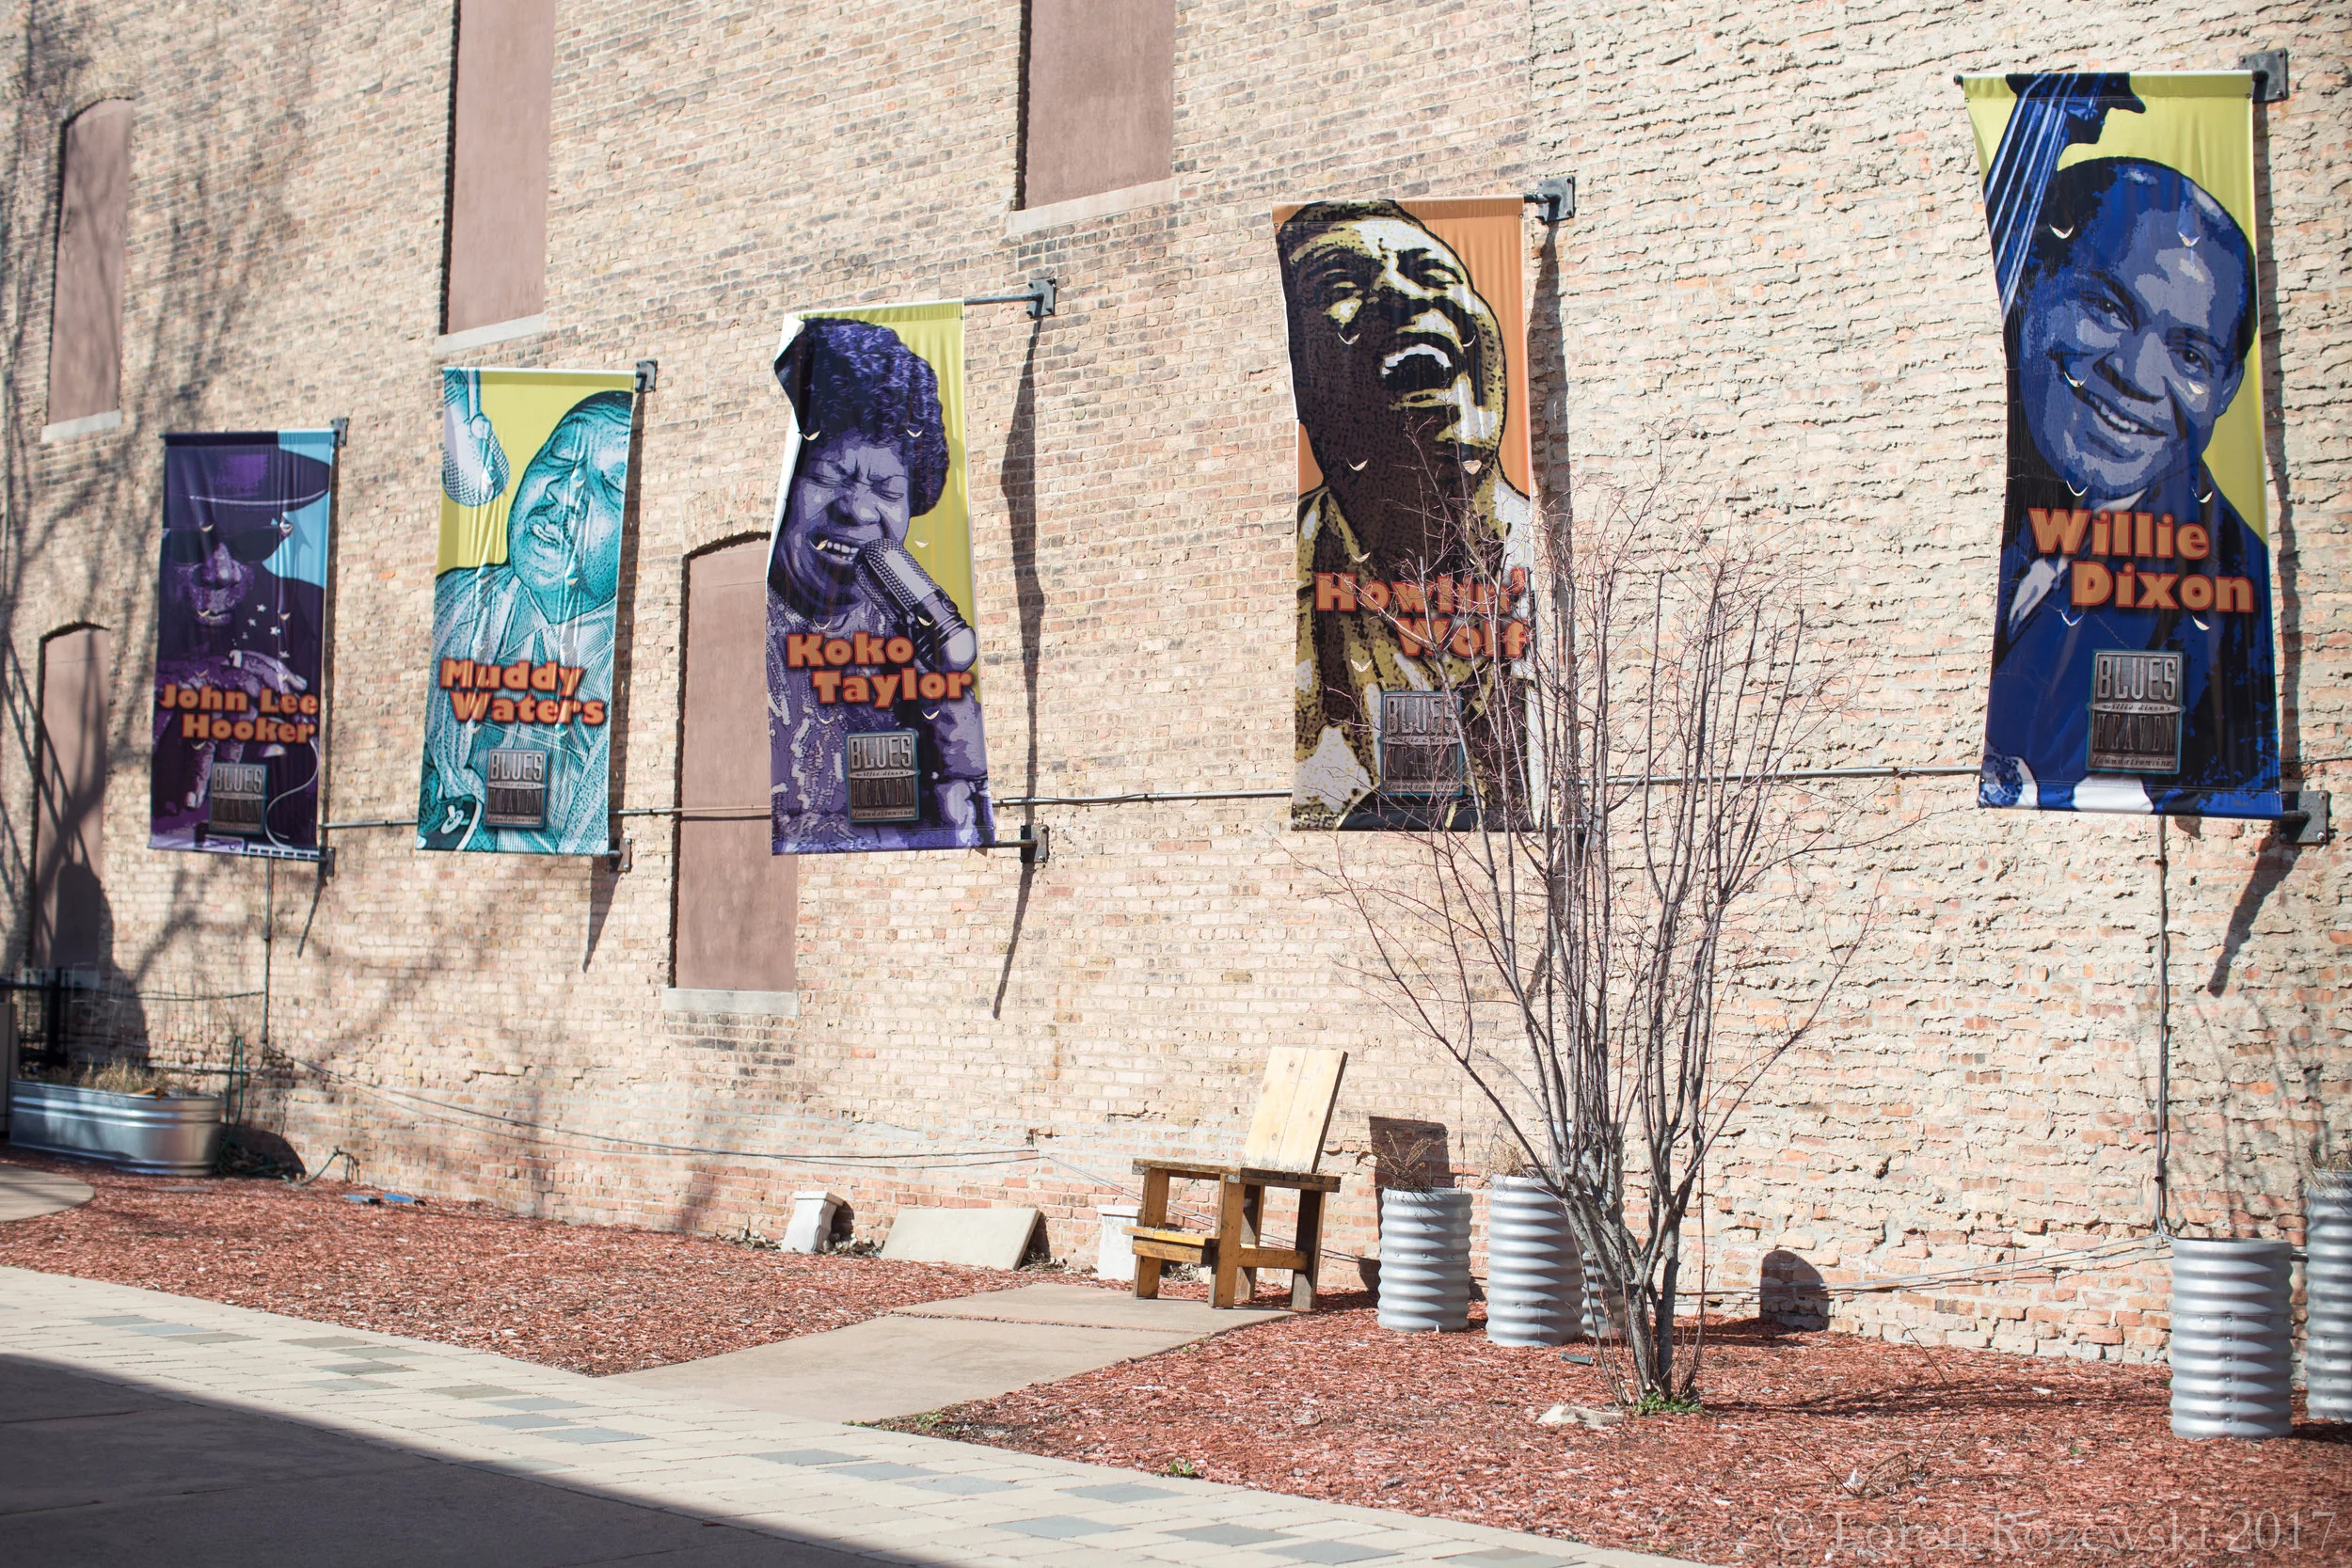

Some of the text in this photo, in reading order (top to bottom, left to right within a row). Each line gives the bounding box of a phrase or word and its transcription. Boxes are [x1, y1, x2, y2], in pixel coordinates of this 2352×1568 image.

[2028, 508, 2210, 561] Willie
[2072, 561, 2254, 613] Dixon
[787, 632, 914, 668] Koko
[1395, 617, 1532, 657] Wolf
[439, 657, 584, 697] Muddy
[812, 667, 974, 708] Taylor
[2097, 656, 2176, 701] BLUES
[159, 684, 319, 715] John Lee
[450, 690, 607, 725] Waters
[1386, 697, 1457, 735] BLUES
[182, 713, 316, 744] Hooker
[2094, 714, 2175, 752] HEAVEN
[490, 753, 543, 781] BLUES
[850, 736, 912, 768] BLUES
[214, 767, 262, 793] BLUES
[852, 778, 913, 806] HEAVEN
